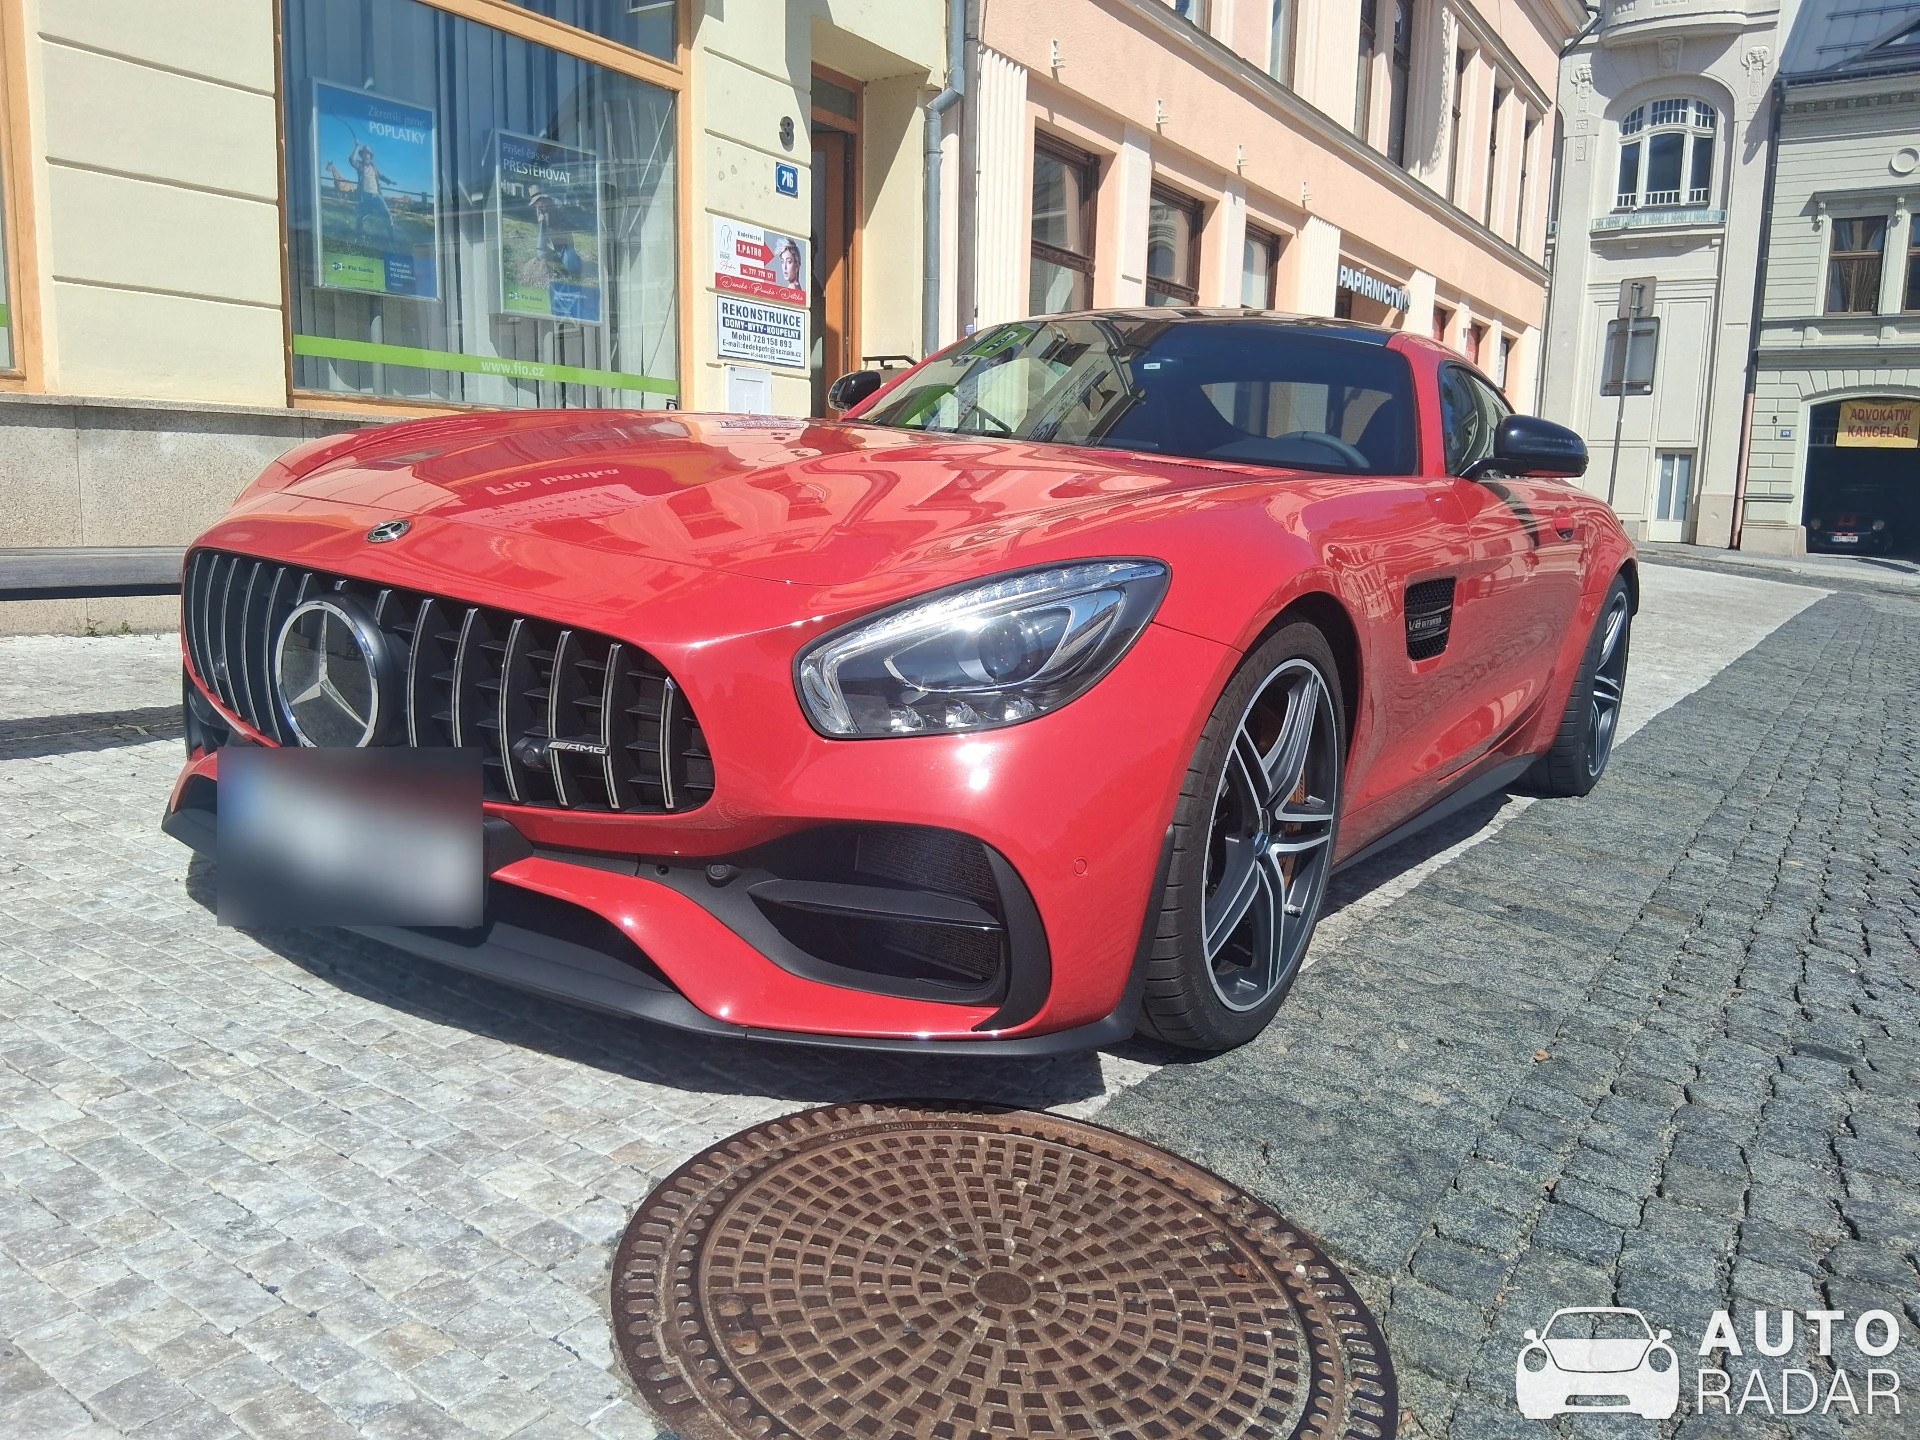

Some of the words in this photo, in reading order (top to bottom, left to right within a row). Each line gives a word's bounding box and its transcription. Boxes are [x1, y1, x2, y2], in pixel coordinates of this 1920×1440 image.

[369, 121, 426, 145] POPLATKY
[779, 116, 794, 146] 3
[503, 157, 572, 184] PŘESTĚHOVAT
[781, 170, 794, 188] 716
[737, 244, 762, 257] 1.PATRO
[1340, 265, 1406, 311] PAPÍRNICTVÍ
[722, 302, 801, 328] REKONSTRUKCE
[731, 331, 751, 342] Mobil
[481, 362, 544, 377] www.fio.cz
[1850, 406, 1912, 421] ADVOKÁTNÍ
[1848, 424, 1909, 438] KANCELÁŘ
[1408, 618, 1421, 631] V8
[567, 743, 607, 754] AMG
